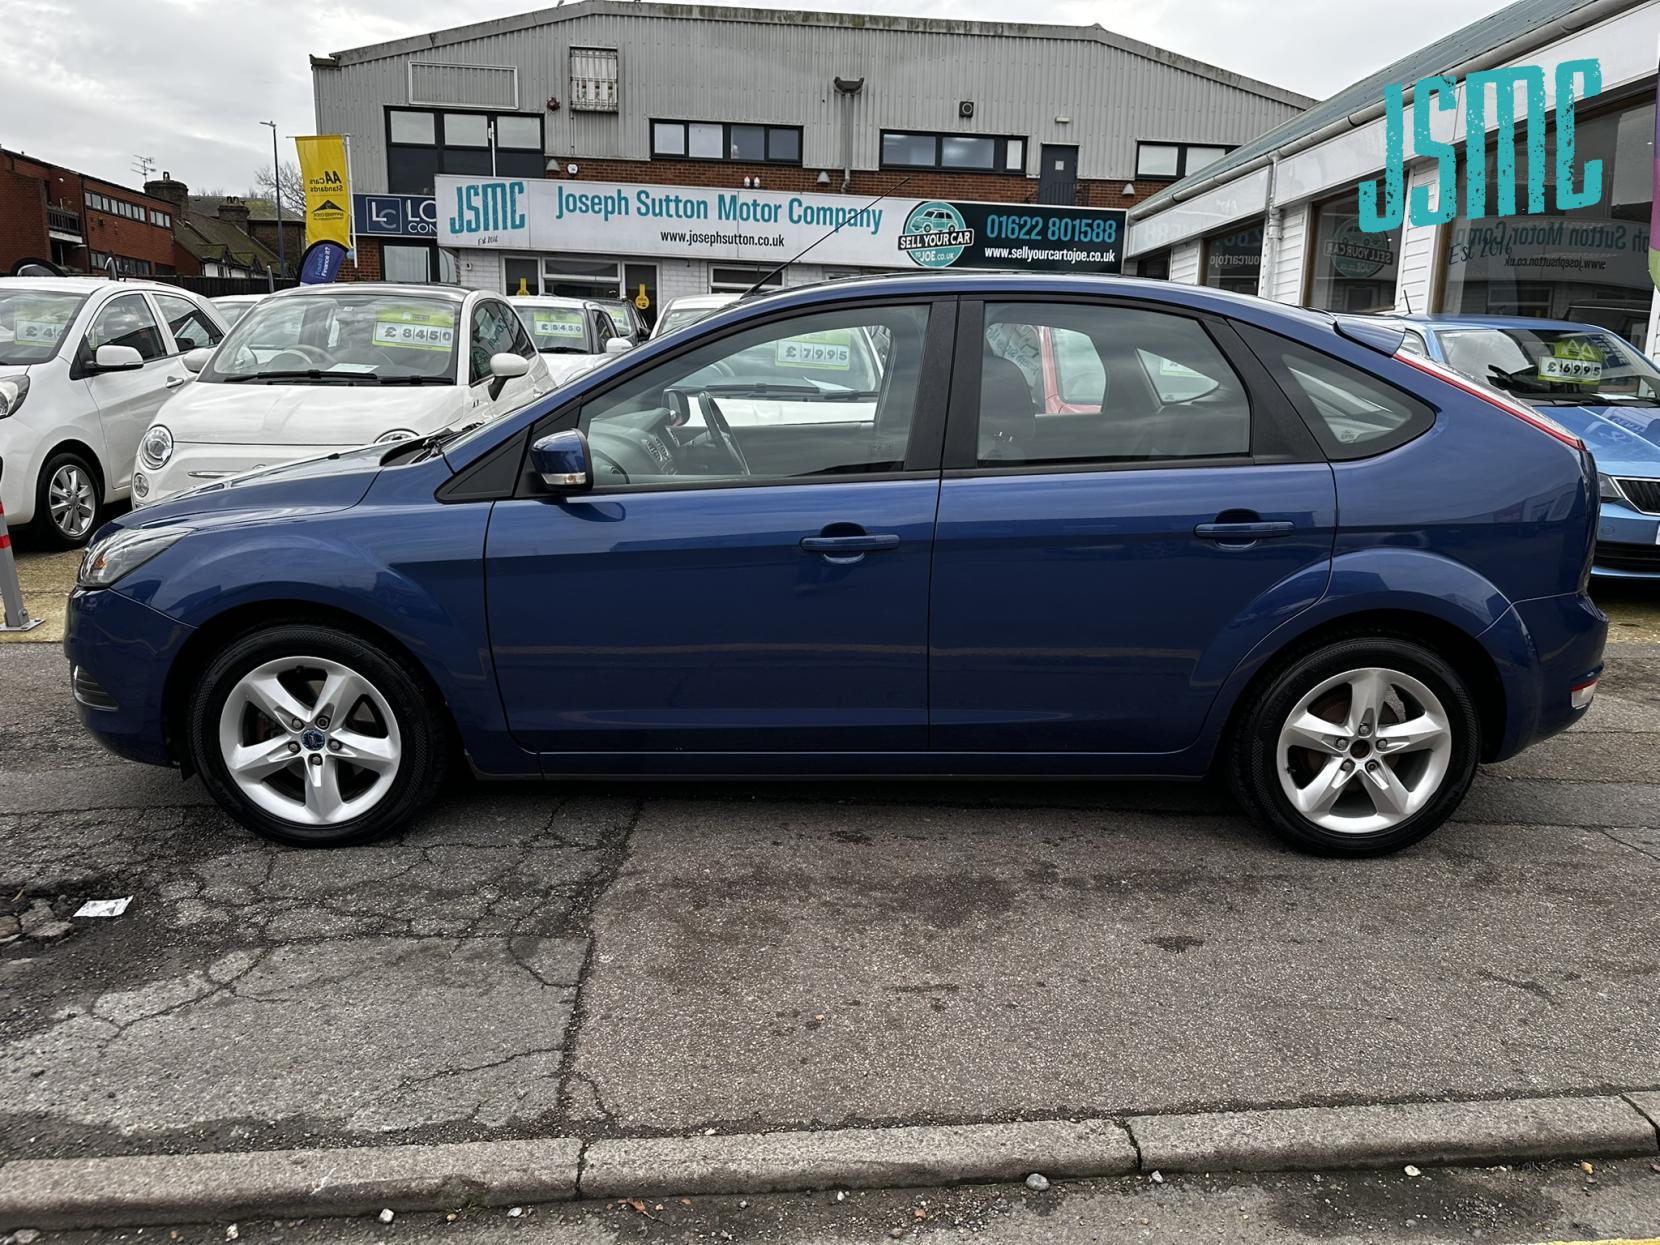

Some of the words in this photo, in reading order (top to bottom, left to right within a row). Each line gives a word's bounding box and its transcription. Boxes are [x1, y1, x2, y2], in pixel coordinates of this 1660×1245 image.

[449, 181, 526, 234] JSMC
[555, 185, 629, 222] Joseph
[636, 189, 708, 220] Sutton
[718, 193, 782, 223] Motor
[788, 197, 883, 235] Company
[986, 214, 1043, 240] 01622
[1048, 217, 1117, 243] 801588
[660, 229, 785, 248] www.josephsutton.co.uk
[900, 236, 922, 249] SELL
[923, 233, 949, 247] YOUR
[950, 232, 971, 245] CAR
[984, 246, 1115, 265] www.sellyourcartojoe.co.uk
[384, 326, 452, 341] £8450
[785, 346, 848, 361] £7995
